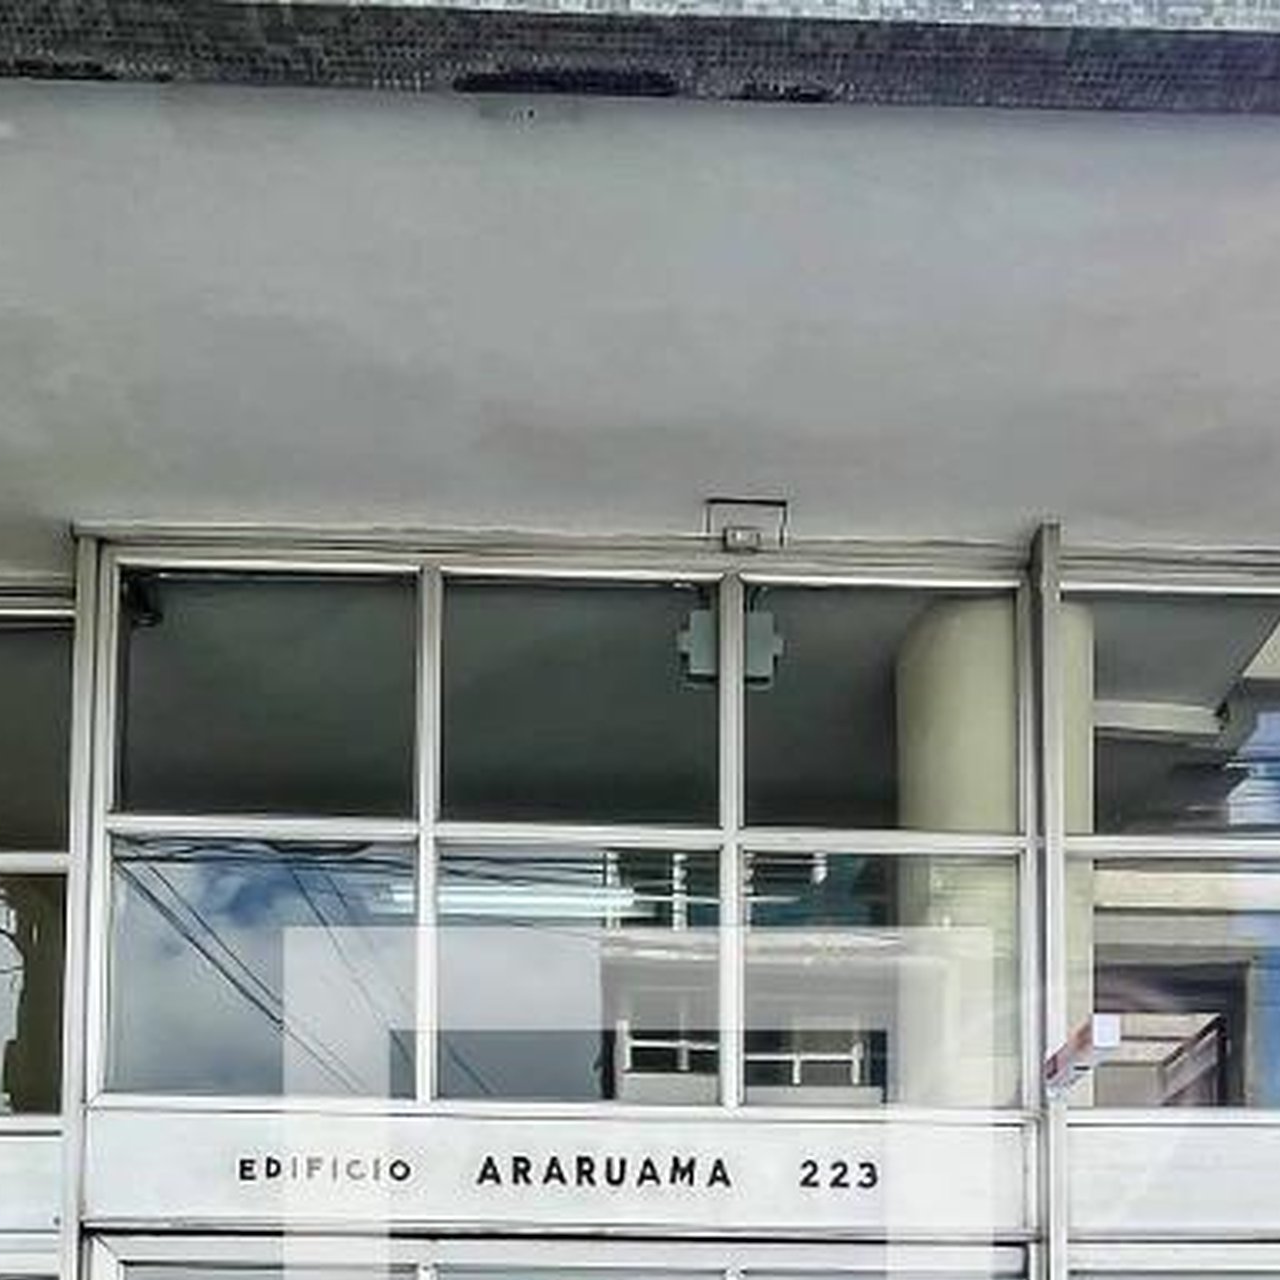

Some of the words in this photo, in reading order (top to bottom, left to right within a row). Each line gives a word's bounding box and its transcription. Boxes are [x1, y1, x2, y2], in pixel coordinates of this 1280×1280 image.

[238, 1156, 412, 1182] EDIFICIO
[476, 1156, 732, 1188] ARARUAMA
[799, 1160, 879, 1188] 223
